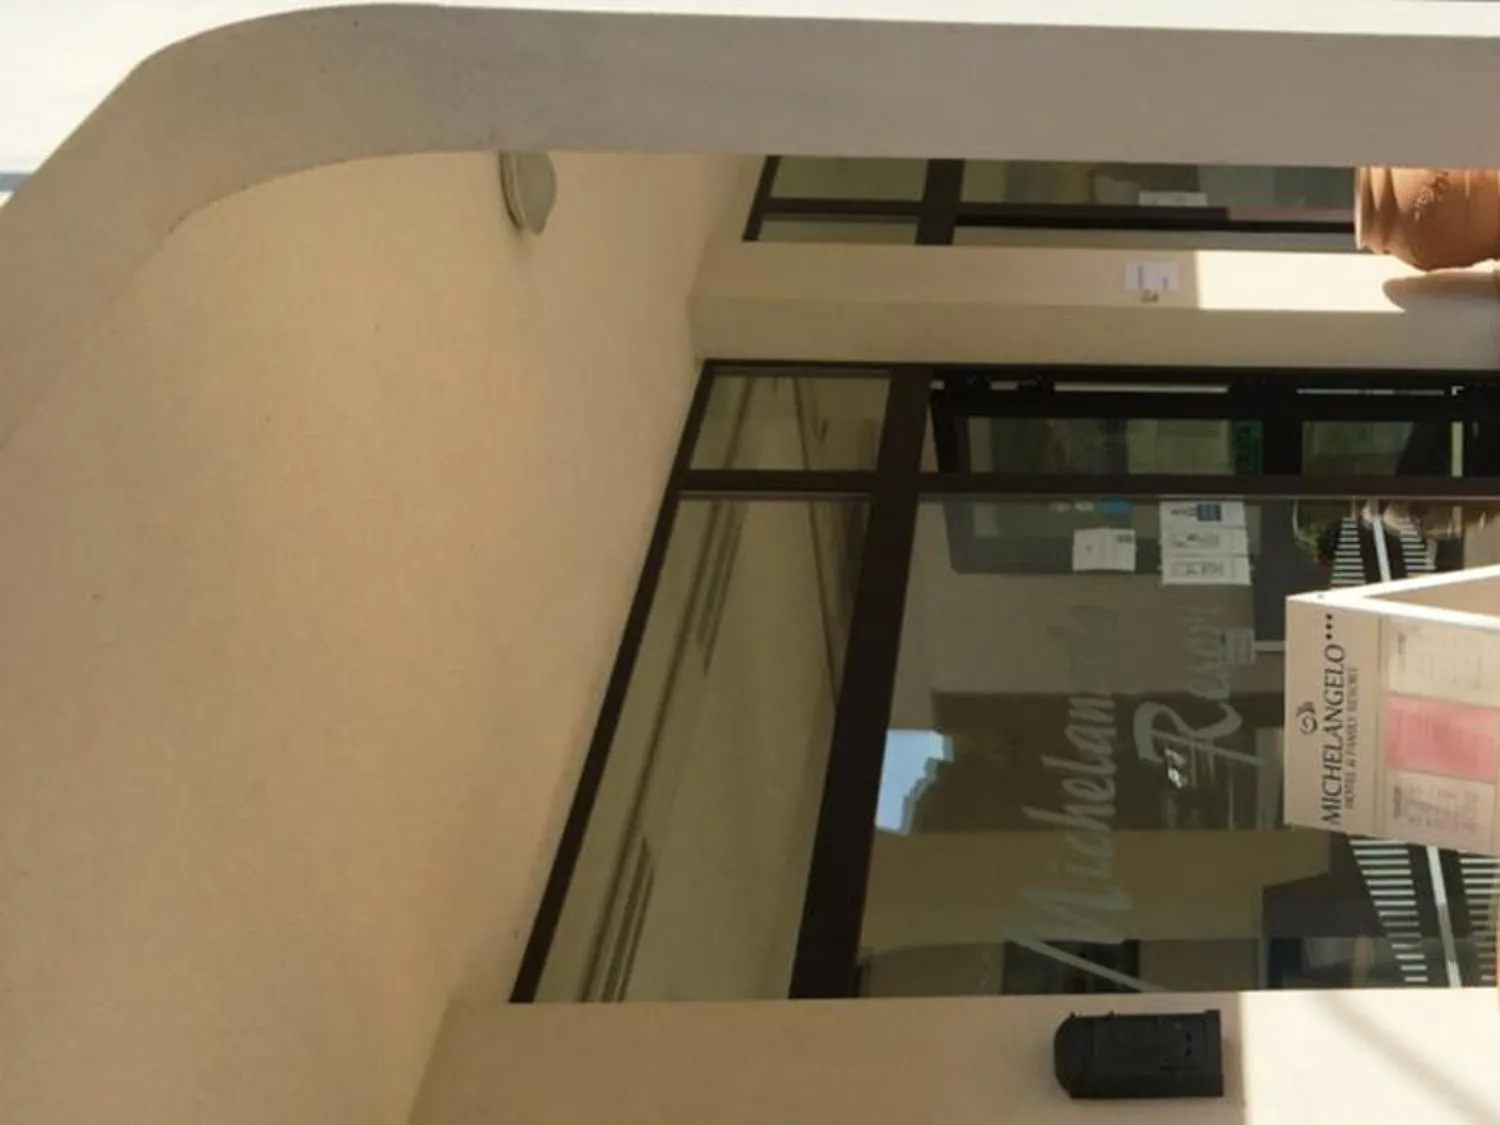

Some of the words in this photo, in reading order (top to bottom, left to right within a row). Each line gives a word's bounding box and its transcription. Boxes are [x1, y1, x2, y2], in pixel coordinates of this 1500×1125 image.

[1000, 605, 1168, 991] Michelan
[1321, 644, 1346, 825] MICHELANGELO
[1345, 773, 1357, 809] HOTEL
